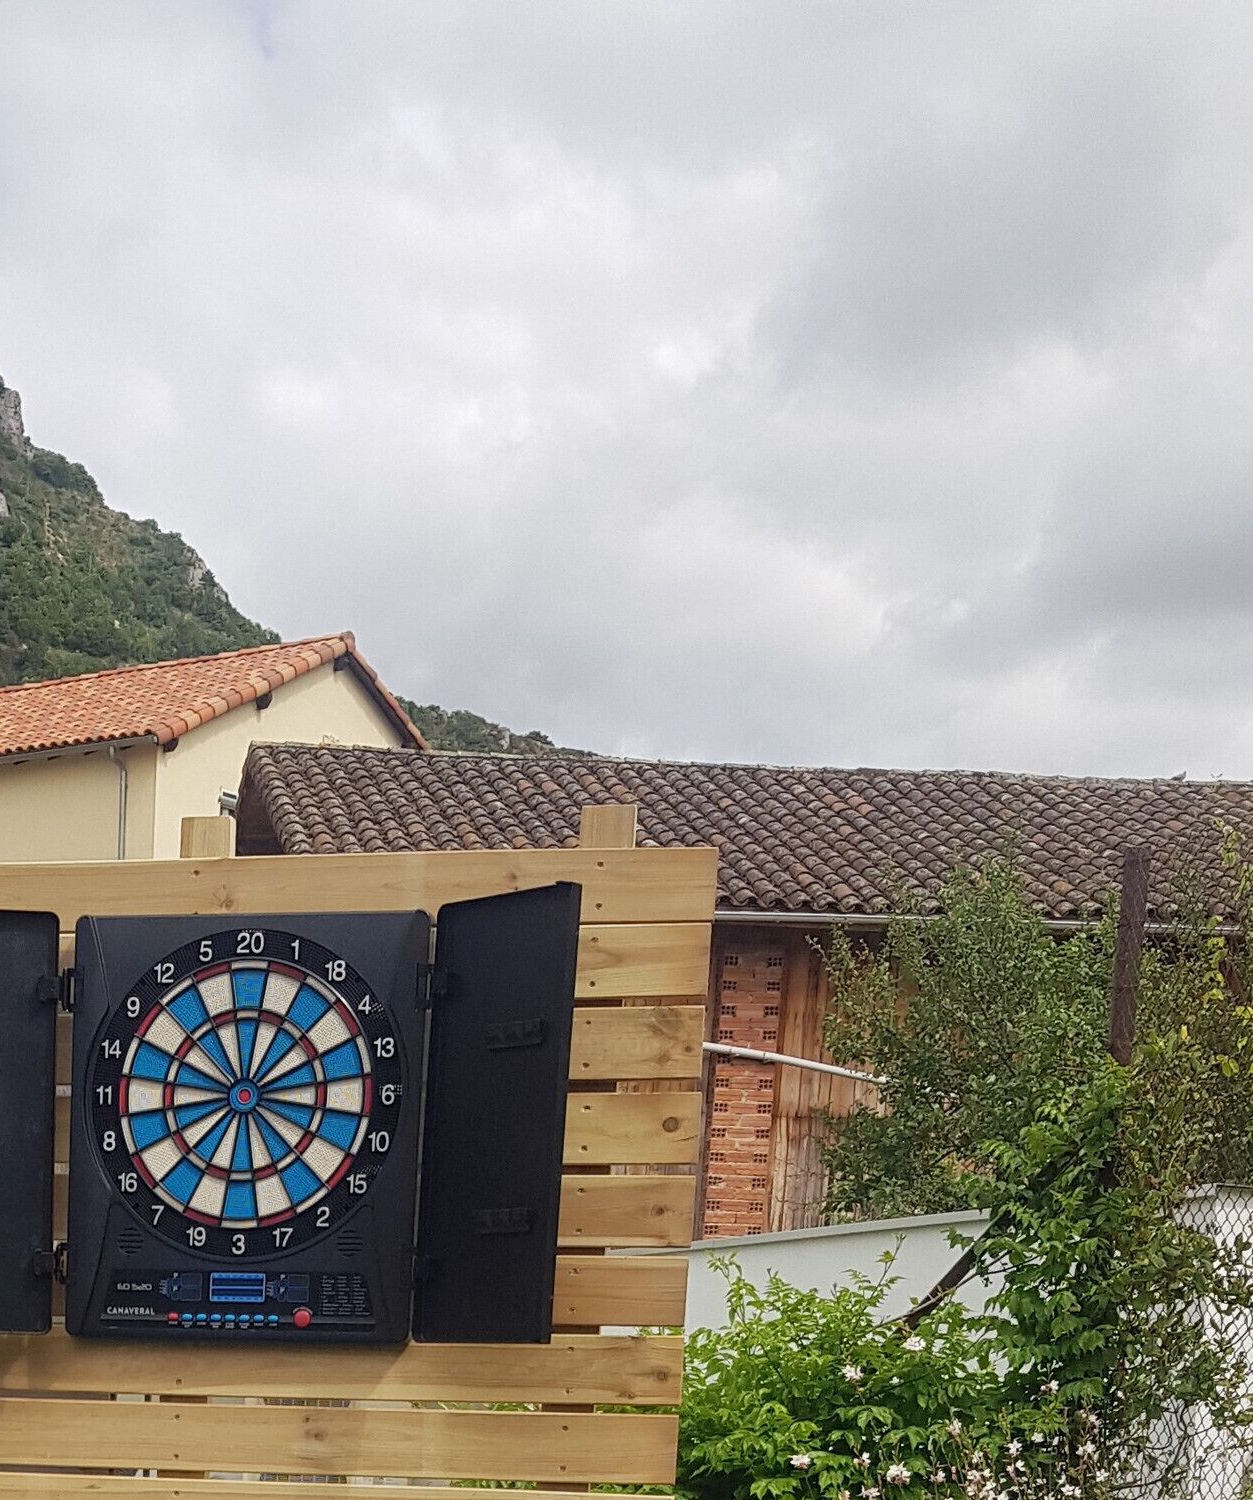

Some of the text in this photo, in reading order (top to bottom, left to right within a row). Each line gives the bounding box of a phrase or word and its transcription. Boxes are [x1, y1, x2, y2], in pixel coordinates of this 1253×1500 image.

[200, 941, 212, 961] 5
[237, 932, 264, 953] 20
[292, 940, 299, 960] 1
[154, 963, 174, 983] 12
[325, 960, 345, 981] 18
[127, 997, 139, 1017] 9
[358, 995, 371, 1013] 4
[102, 1040, 121, 1058] 14
[374, 1038, 394, 1057] 13
[97, 1086, 111, 1104] 11
[382, 1084, 394, 1104] 6
[103, 1131, 115, 1151] 8
[369, 1132, 389, 1151] 10
[118, 1173, 137, 1192] 16
[347, 1174, 366, 1193] 15
[152, 1206, 164, 1225] 7
[317, 1207, 329, 1226] 2
[187, 1227, 206, 1246] 19
[232, 1234, 245, 1254] 3
[273, 1228, 293, 1246] 17
[107, 1306, 155, 1315] CANAVERAL
